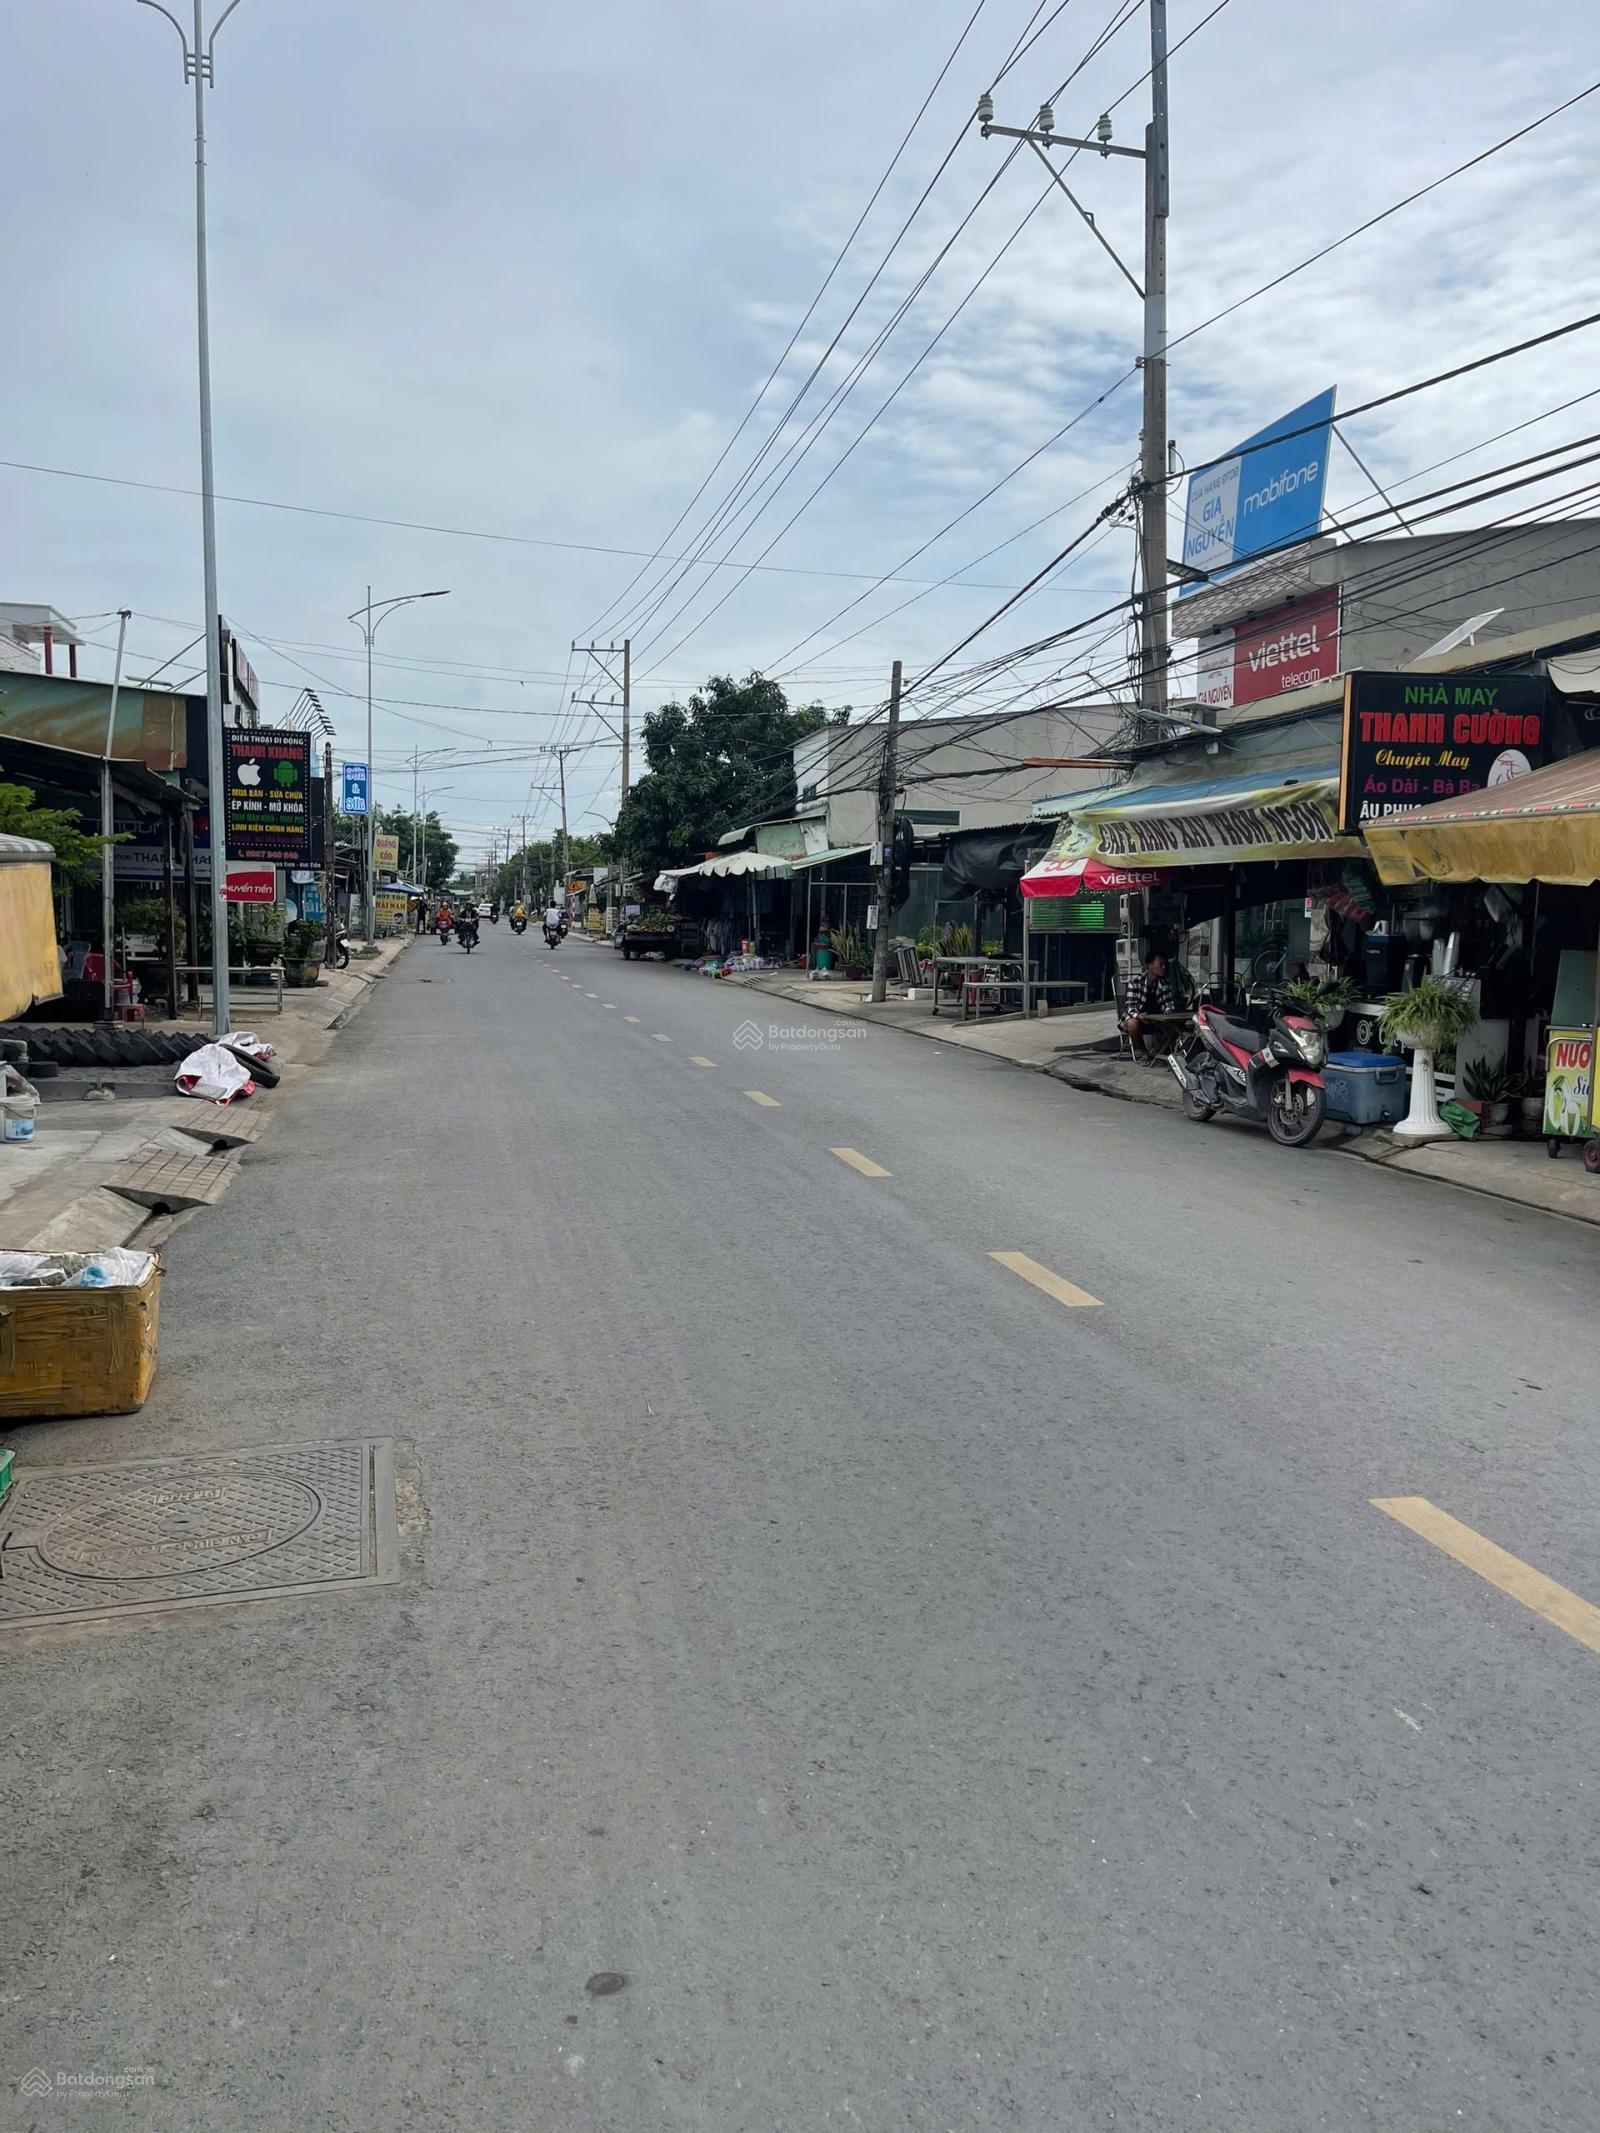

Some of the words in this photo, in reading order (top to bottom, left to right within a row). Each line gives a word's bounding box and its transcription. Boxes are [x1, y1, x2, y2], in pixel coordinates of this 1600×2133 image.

[1243, 461, 1319, 516] mobifone
[1203, 496, 1222, 522] GIA
[1248, 624, 1320, 673] viettel
[1281, 667, 1320, 689] telecom
[1404, 683, 1448, 705] NHÀ
[1455, 687, 1499, 706] MAY
[1360, 712, 1446, 743] THANH
[1453, 709, 1542, 745] CƯỜNG
[251, 735, 272, 744] THOẠI
[231, 744, 266, 758] THANH
[268, 746, 304, 759] KHANG
[1375, 749, 1431, 770] Chuyên
[1434, 751, 1471, 770] May
[1364, 775, 1388, 793] Áo
[1392, 778, 1418, 794] Dài
[231, 798, 241, 810] ÉP
[1360, 801, 1380, 819] ÂU
[1098, 821, 1138, 856] CAFE
[1134, 818, 1178, 852] RANG
[1174, 814, 1216, 848] XAY
[1260, 800, 1335, 842] NGON
[1100, 871, 1160, 885] viettel
